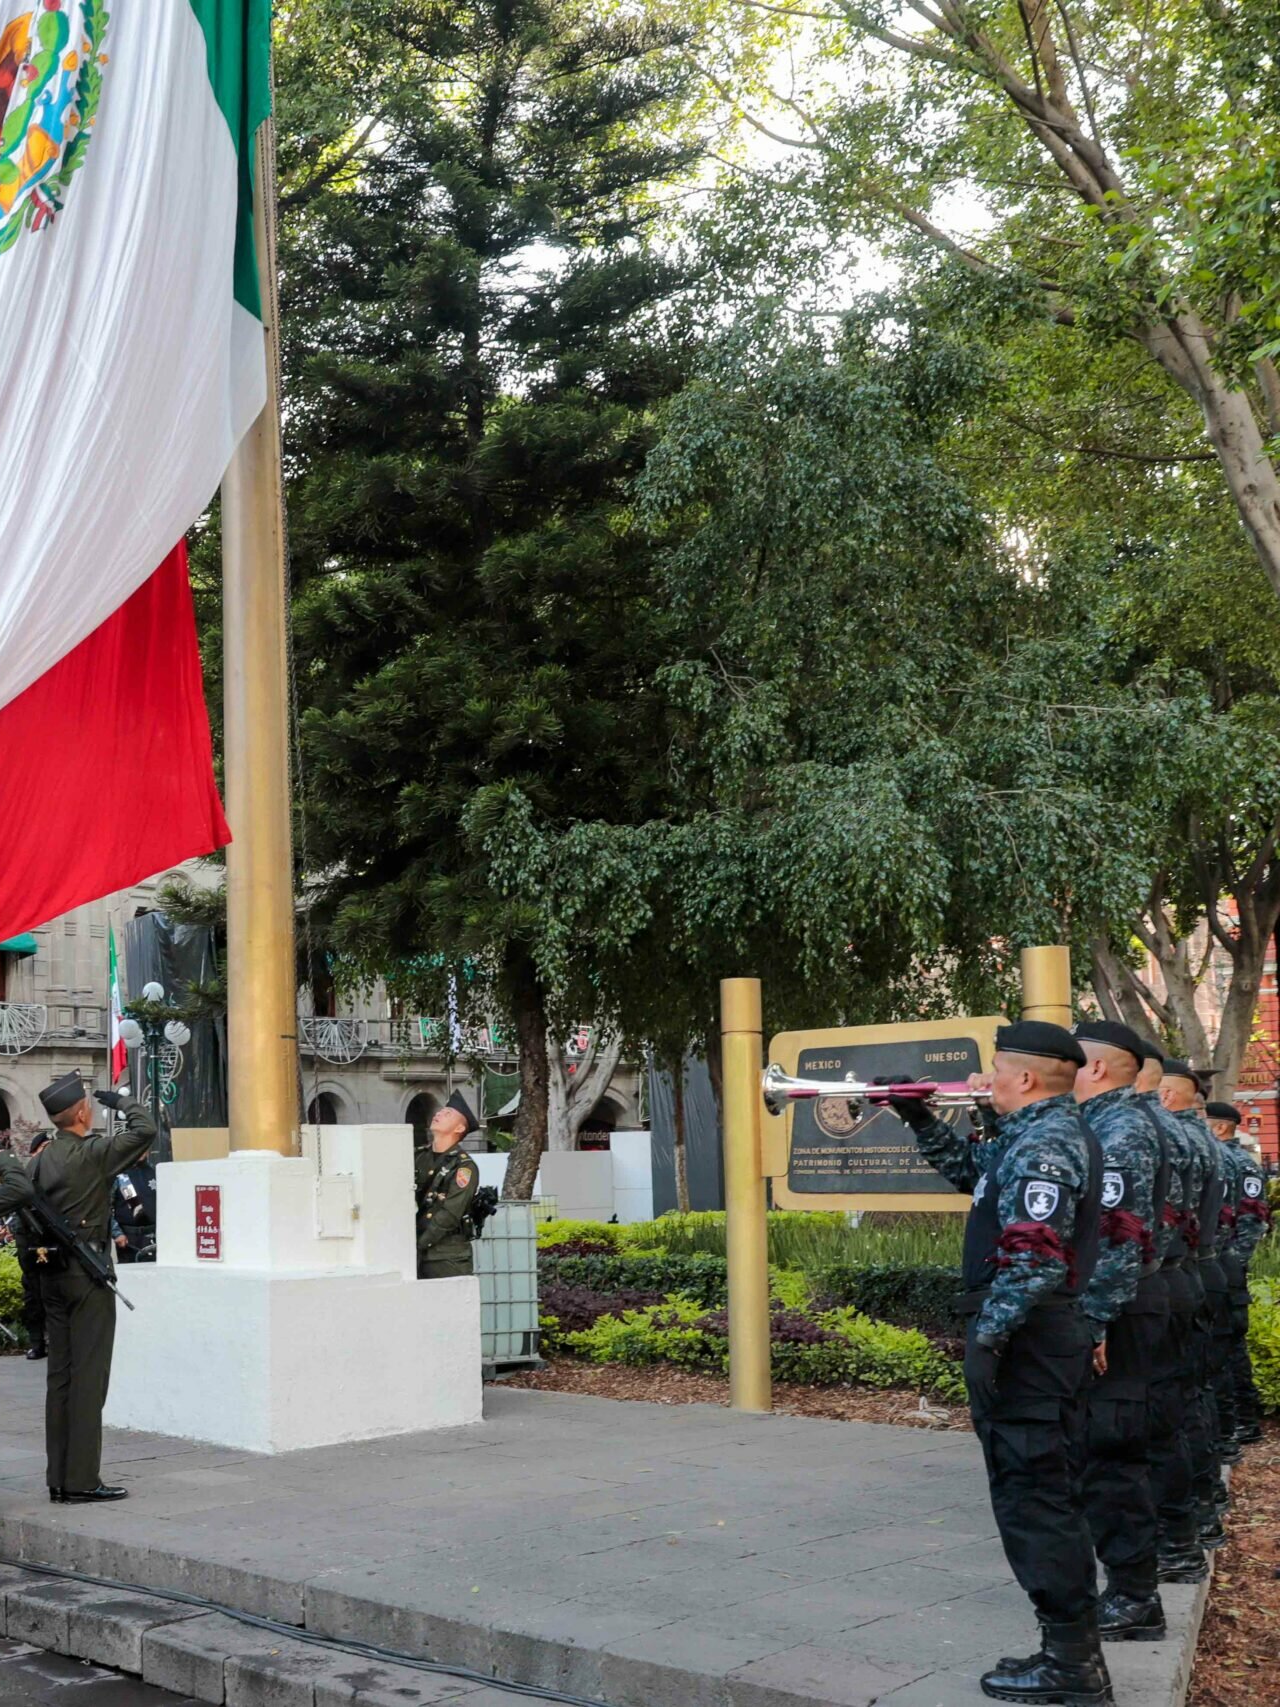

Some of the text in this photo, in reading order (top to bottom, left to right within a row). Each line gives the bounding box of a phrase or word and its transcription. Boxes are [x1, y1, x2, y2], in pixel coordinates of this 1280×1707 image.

[925, 1051, 968, 1063] UNESCO
[805, 1060, 841, 1071] MEXICO
[899, 1158, 910, 1166] DE
[916, 1158, 929, 1166] LA
